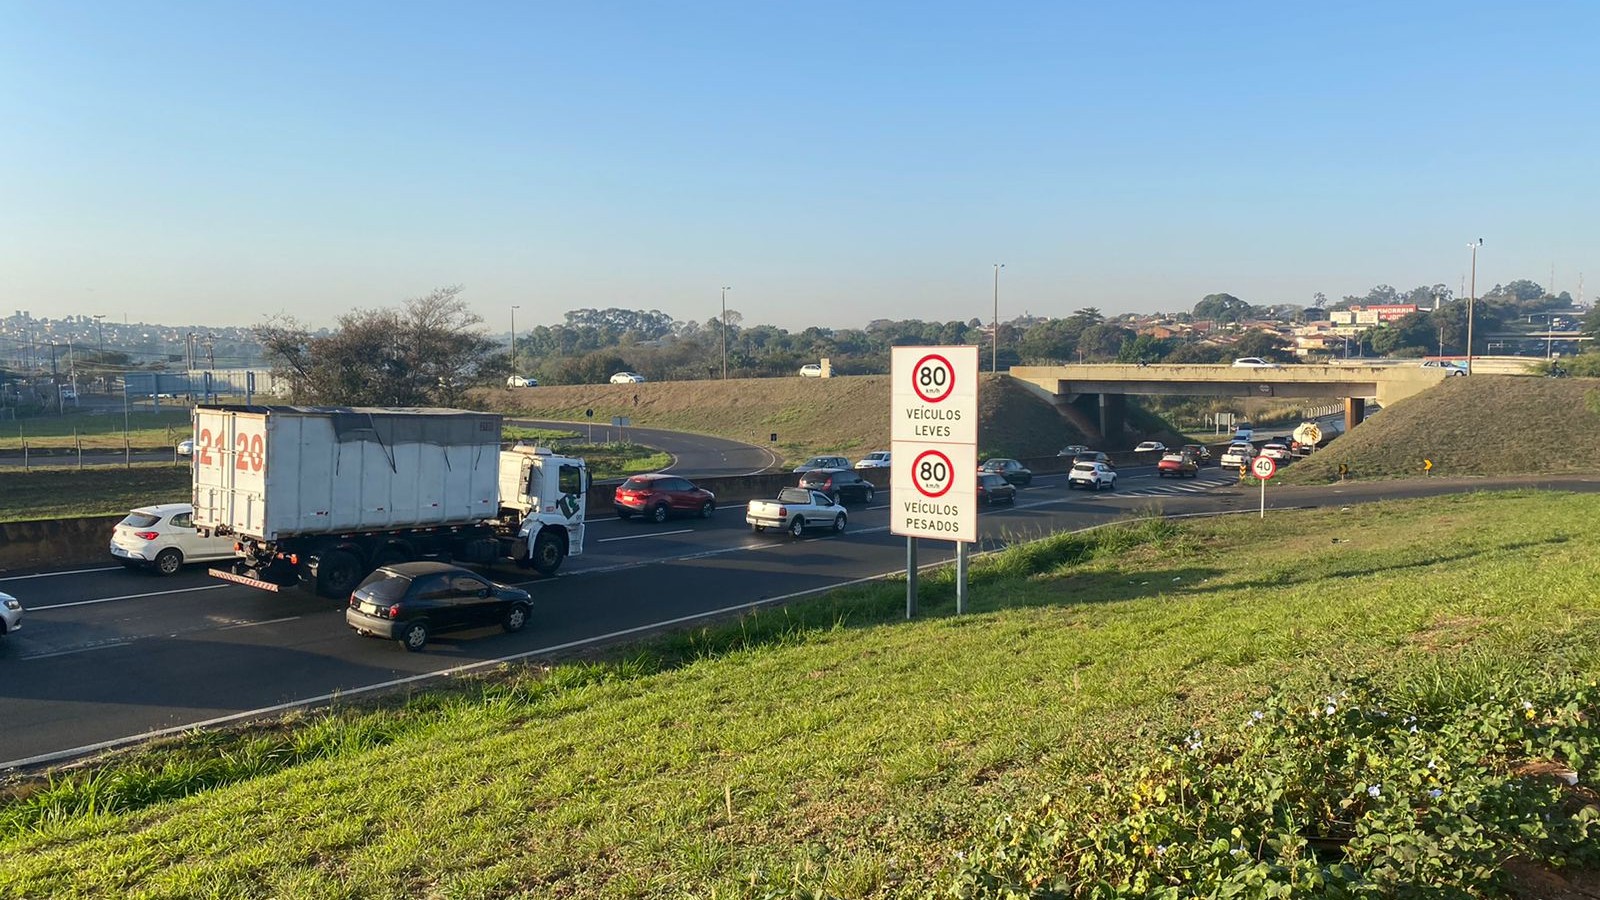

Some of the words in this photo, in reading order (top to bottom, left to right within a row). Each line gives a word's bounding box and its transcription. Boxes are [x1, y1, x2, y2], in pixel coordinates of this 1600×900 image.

[920, 366, 946, 386] 80
[906, 405, 961, 421] VEÍCULOS
[915, 425, 951, 437] LEVES
[920, 461, 946, 482] 80
[1257, 461, 1270, 471] 40
[904, 500, 959, 516] VEÍCULOS
[906, 518, 959, 533] PESADOS
